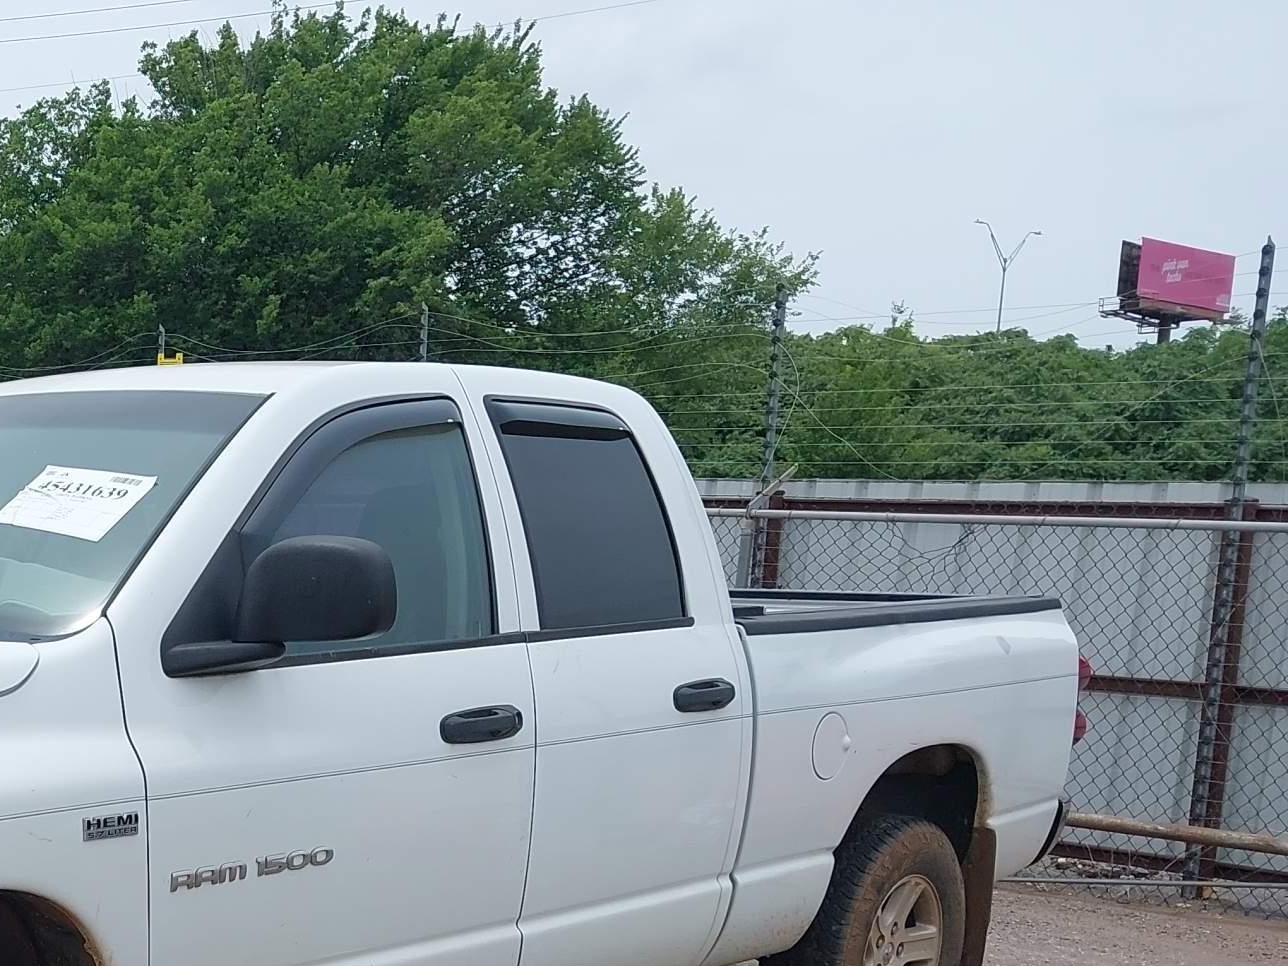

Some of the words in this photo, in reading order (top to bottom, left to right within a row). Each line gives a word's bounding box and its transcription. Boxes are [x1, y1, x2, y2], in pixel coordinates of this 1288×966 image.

[38, 480, 129, 500] 45431639
[86, 813, 139, 831] HEMI
[107, 826, 137, 836] LITER
[170, 860, 248, 893] RAM
[255, 845, 335, 878] 1500
